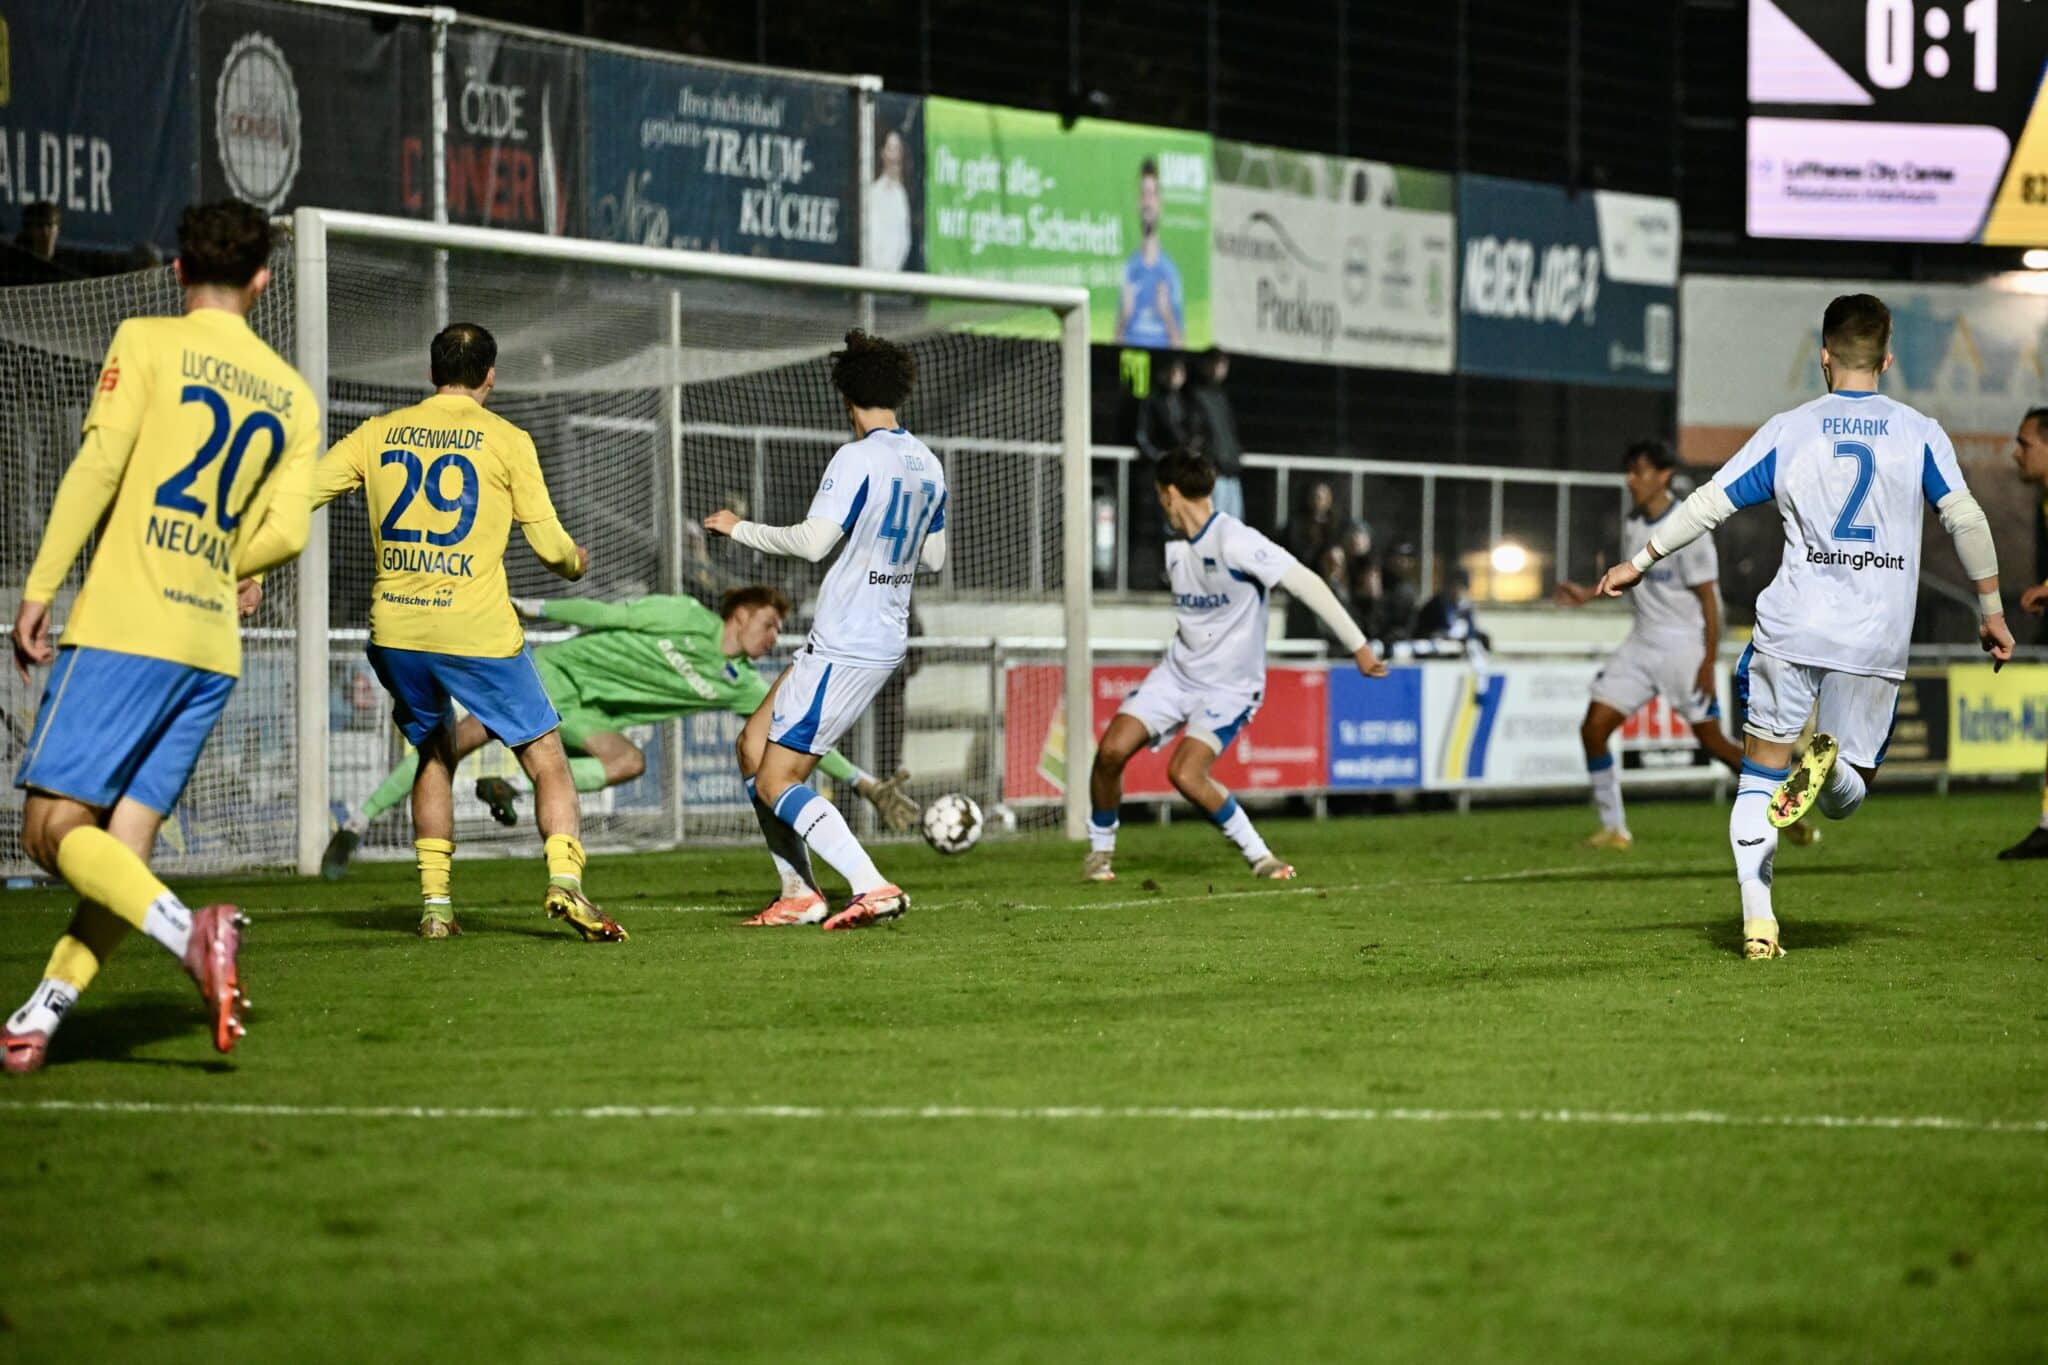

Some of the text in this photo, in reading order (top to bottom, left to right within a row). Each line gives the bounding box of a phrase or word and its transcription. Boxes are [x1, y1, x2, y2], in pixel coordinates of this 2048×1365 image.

[739, 181, 840, 243] KÜCHE
[182, 350, 293, 419] LUCKENWALDE
[385, 426, 484, 450] LUCKENWALDE
[1822, 417, 1889, 436] PEKARIK
[155, 385, 285, 533] 20
[380, 449, 479, 547] 29
[1831, 440, 1876, 543] 2
[383, 547, 474, 578] GOLLNACK
[1806, 545, 1905, 571] BearingPoint
[381, 591, 432, 607] Märkischer
